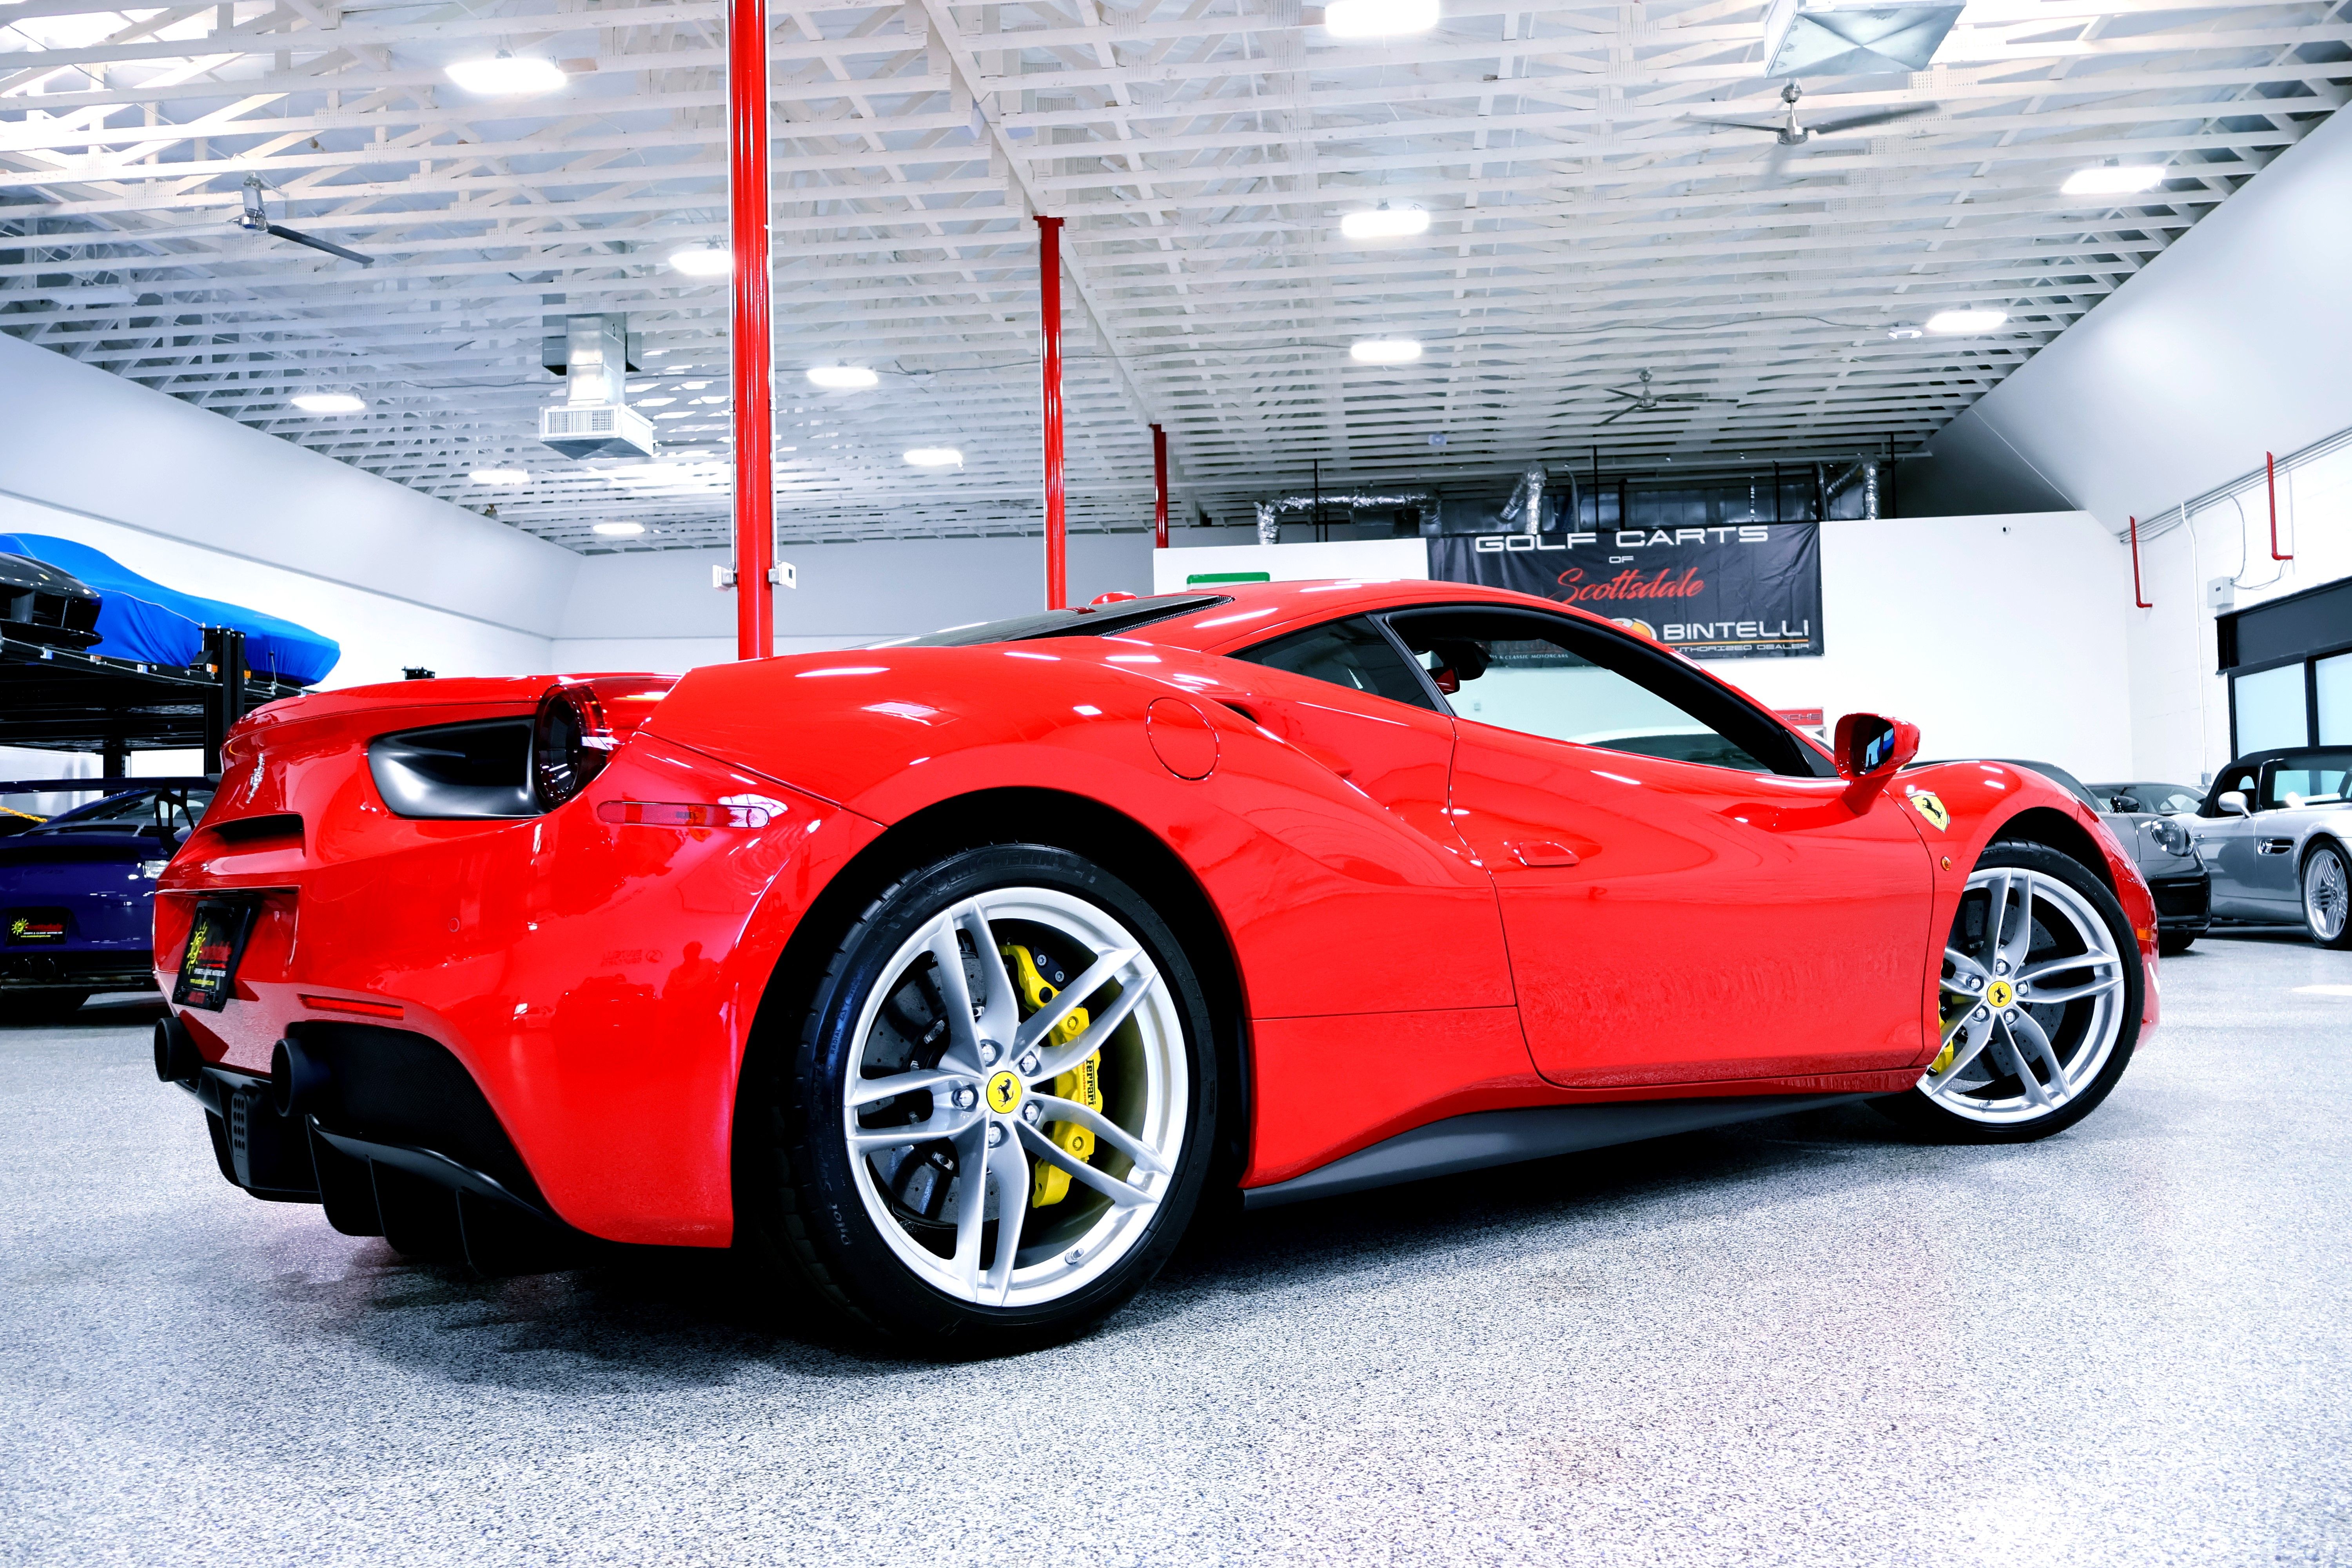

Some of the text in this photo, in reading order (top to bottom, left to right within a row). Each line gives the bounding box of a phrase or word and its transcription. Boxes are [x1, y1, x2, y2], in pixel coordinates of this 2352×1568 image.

[1475, 526, 1768, 552] GOLF CARTS
[1609, 555, 1634, 564] OF
[1550, 567, 1704, 604] Scottsdale
[1663, 620, 1809, 641] BINTELLI
[830, 1028, 841, 1054] RADIAL
[1086, 1059, 1096, 1105] Ferrari
